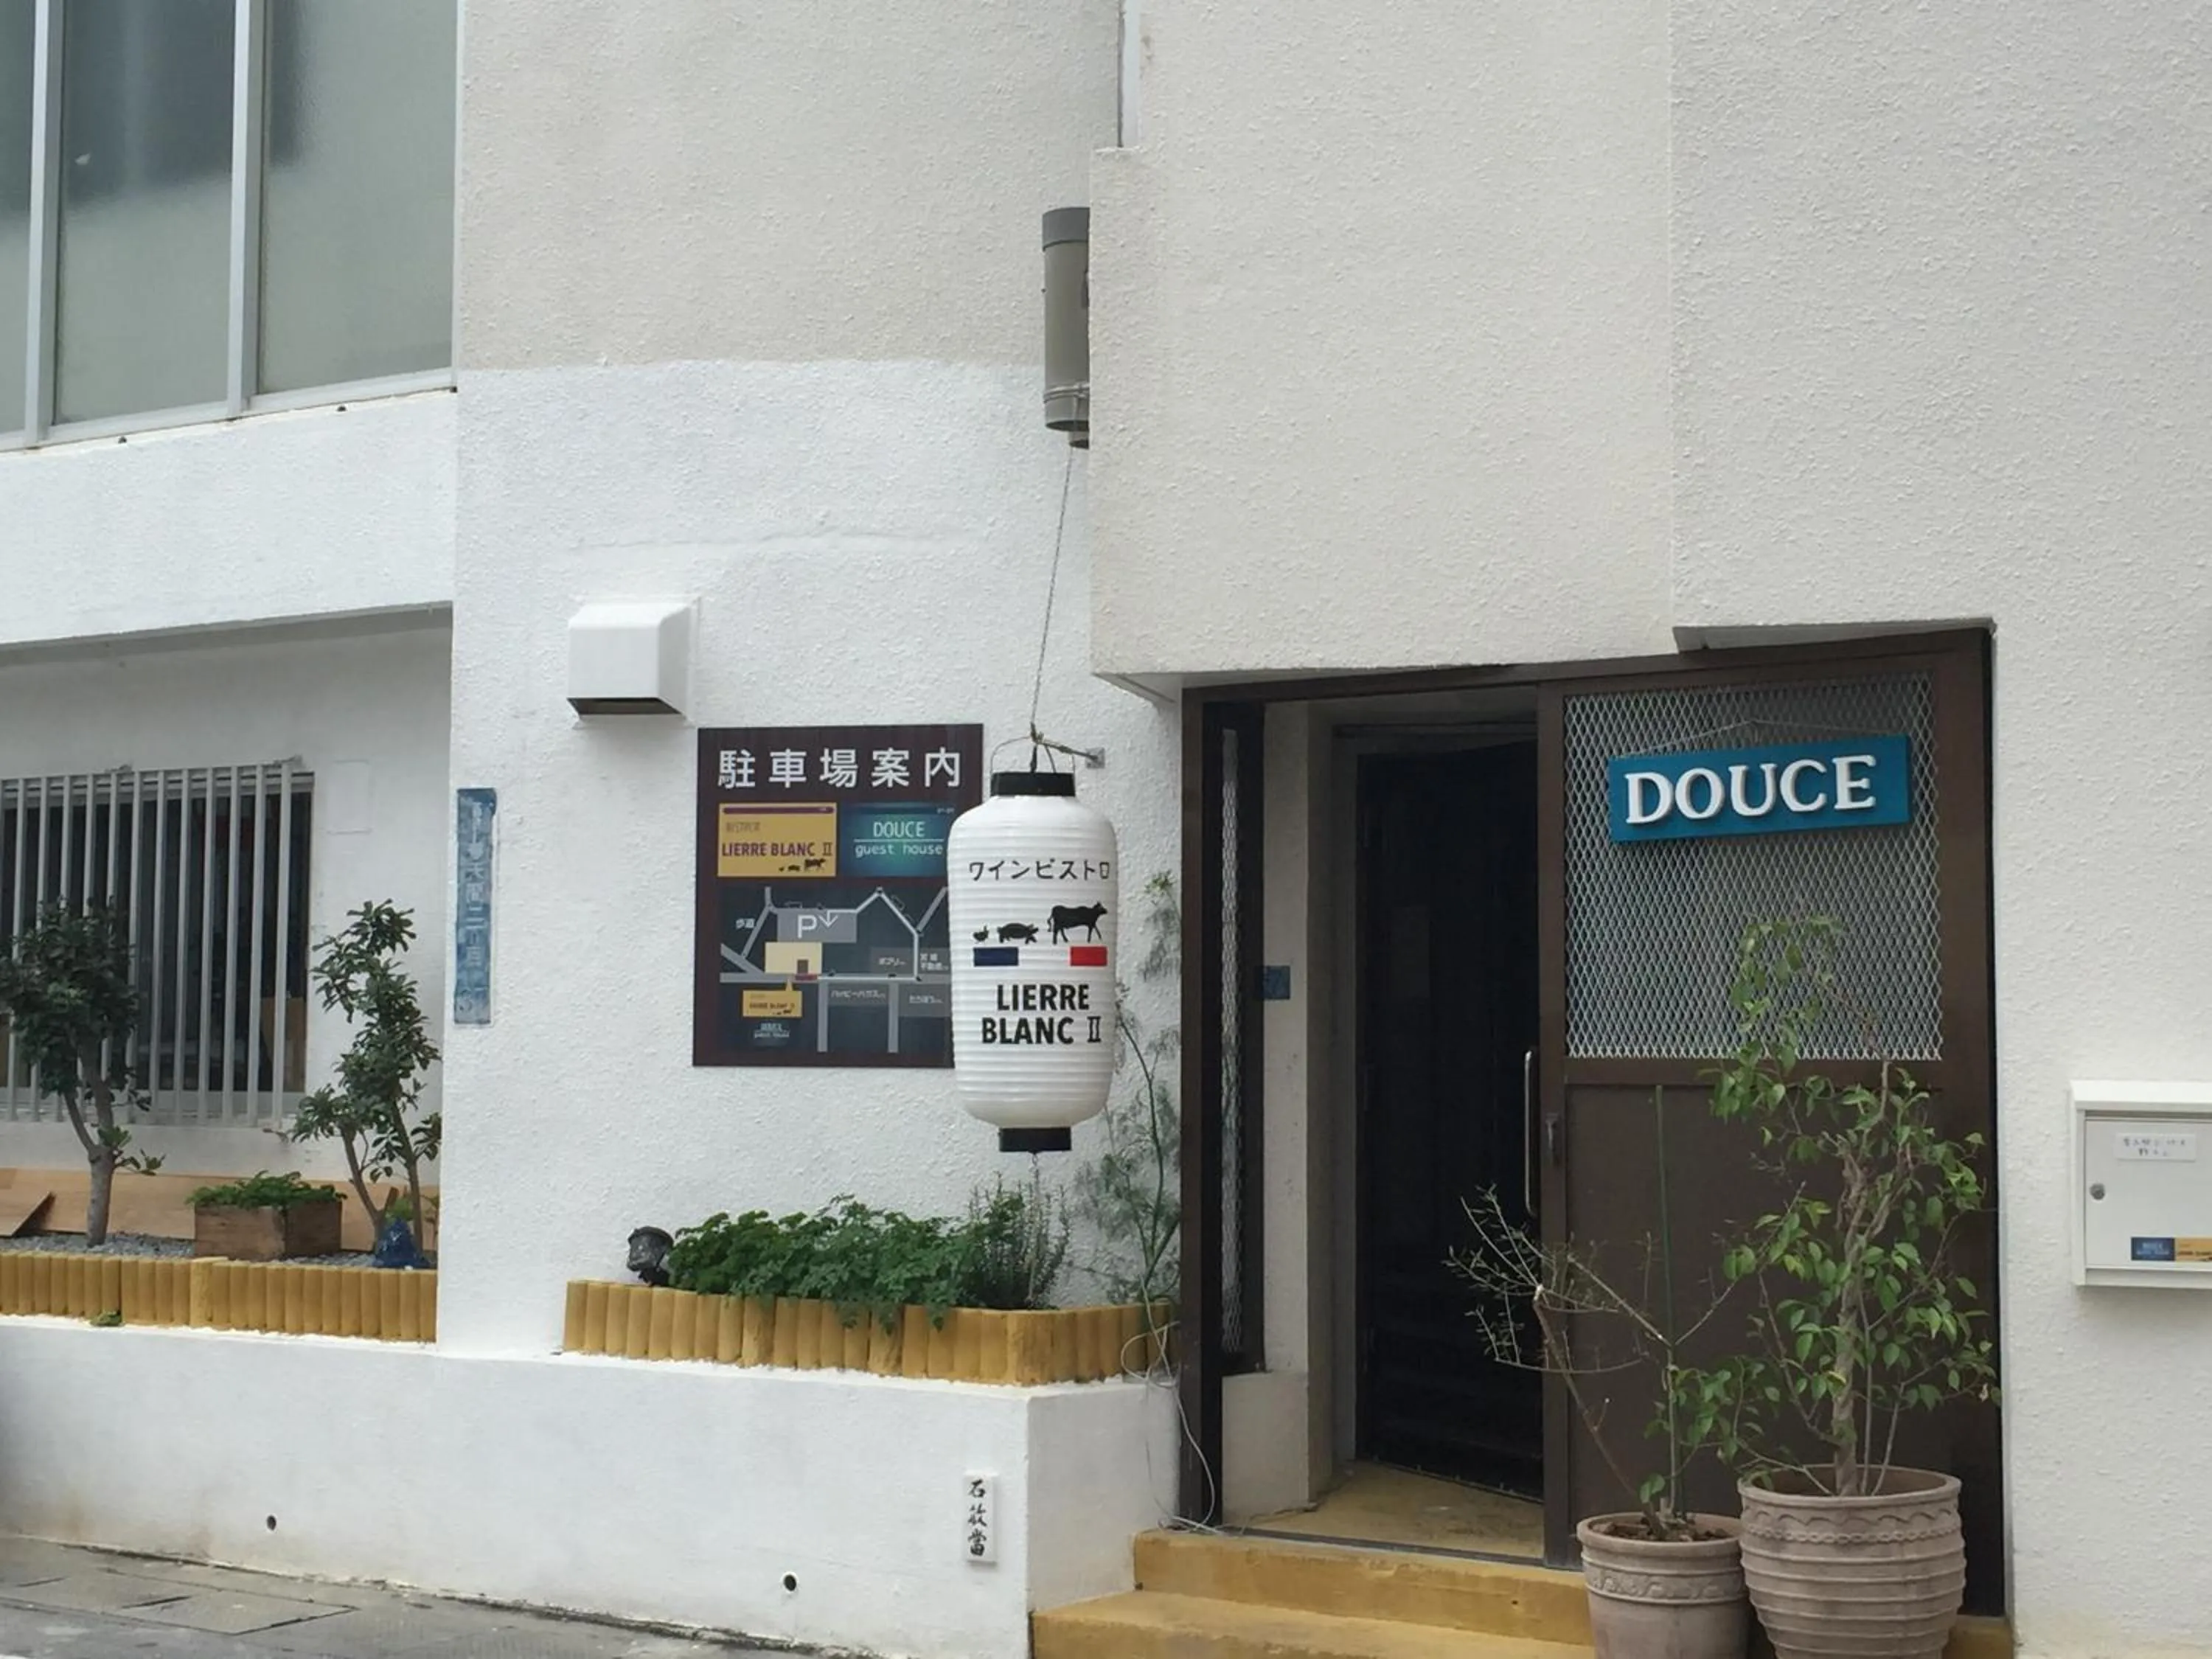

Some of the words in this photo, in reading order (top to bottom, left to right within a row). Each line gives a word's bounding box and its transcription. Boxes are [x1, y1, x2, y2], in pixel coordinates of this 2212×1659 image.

[717, 746, 961, 789] 駐車場案内
[1625, 754, 1877, 824] DOUCE
[873, 821, 926, 838] DOUCE
[722, 842, 768, 857] LIERRE
[771, 841, 815, 857] BLANC
[855, 844, 895, 859] guest
[902, 844, 943, 855] house
[969, 858, 1110, 881] ワインビストロ
[797, 914, 817, 939] P
[996, 984, 1090, 1011] LIERRE
[981, 1015, 1074, 1044] BLANC
